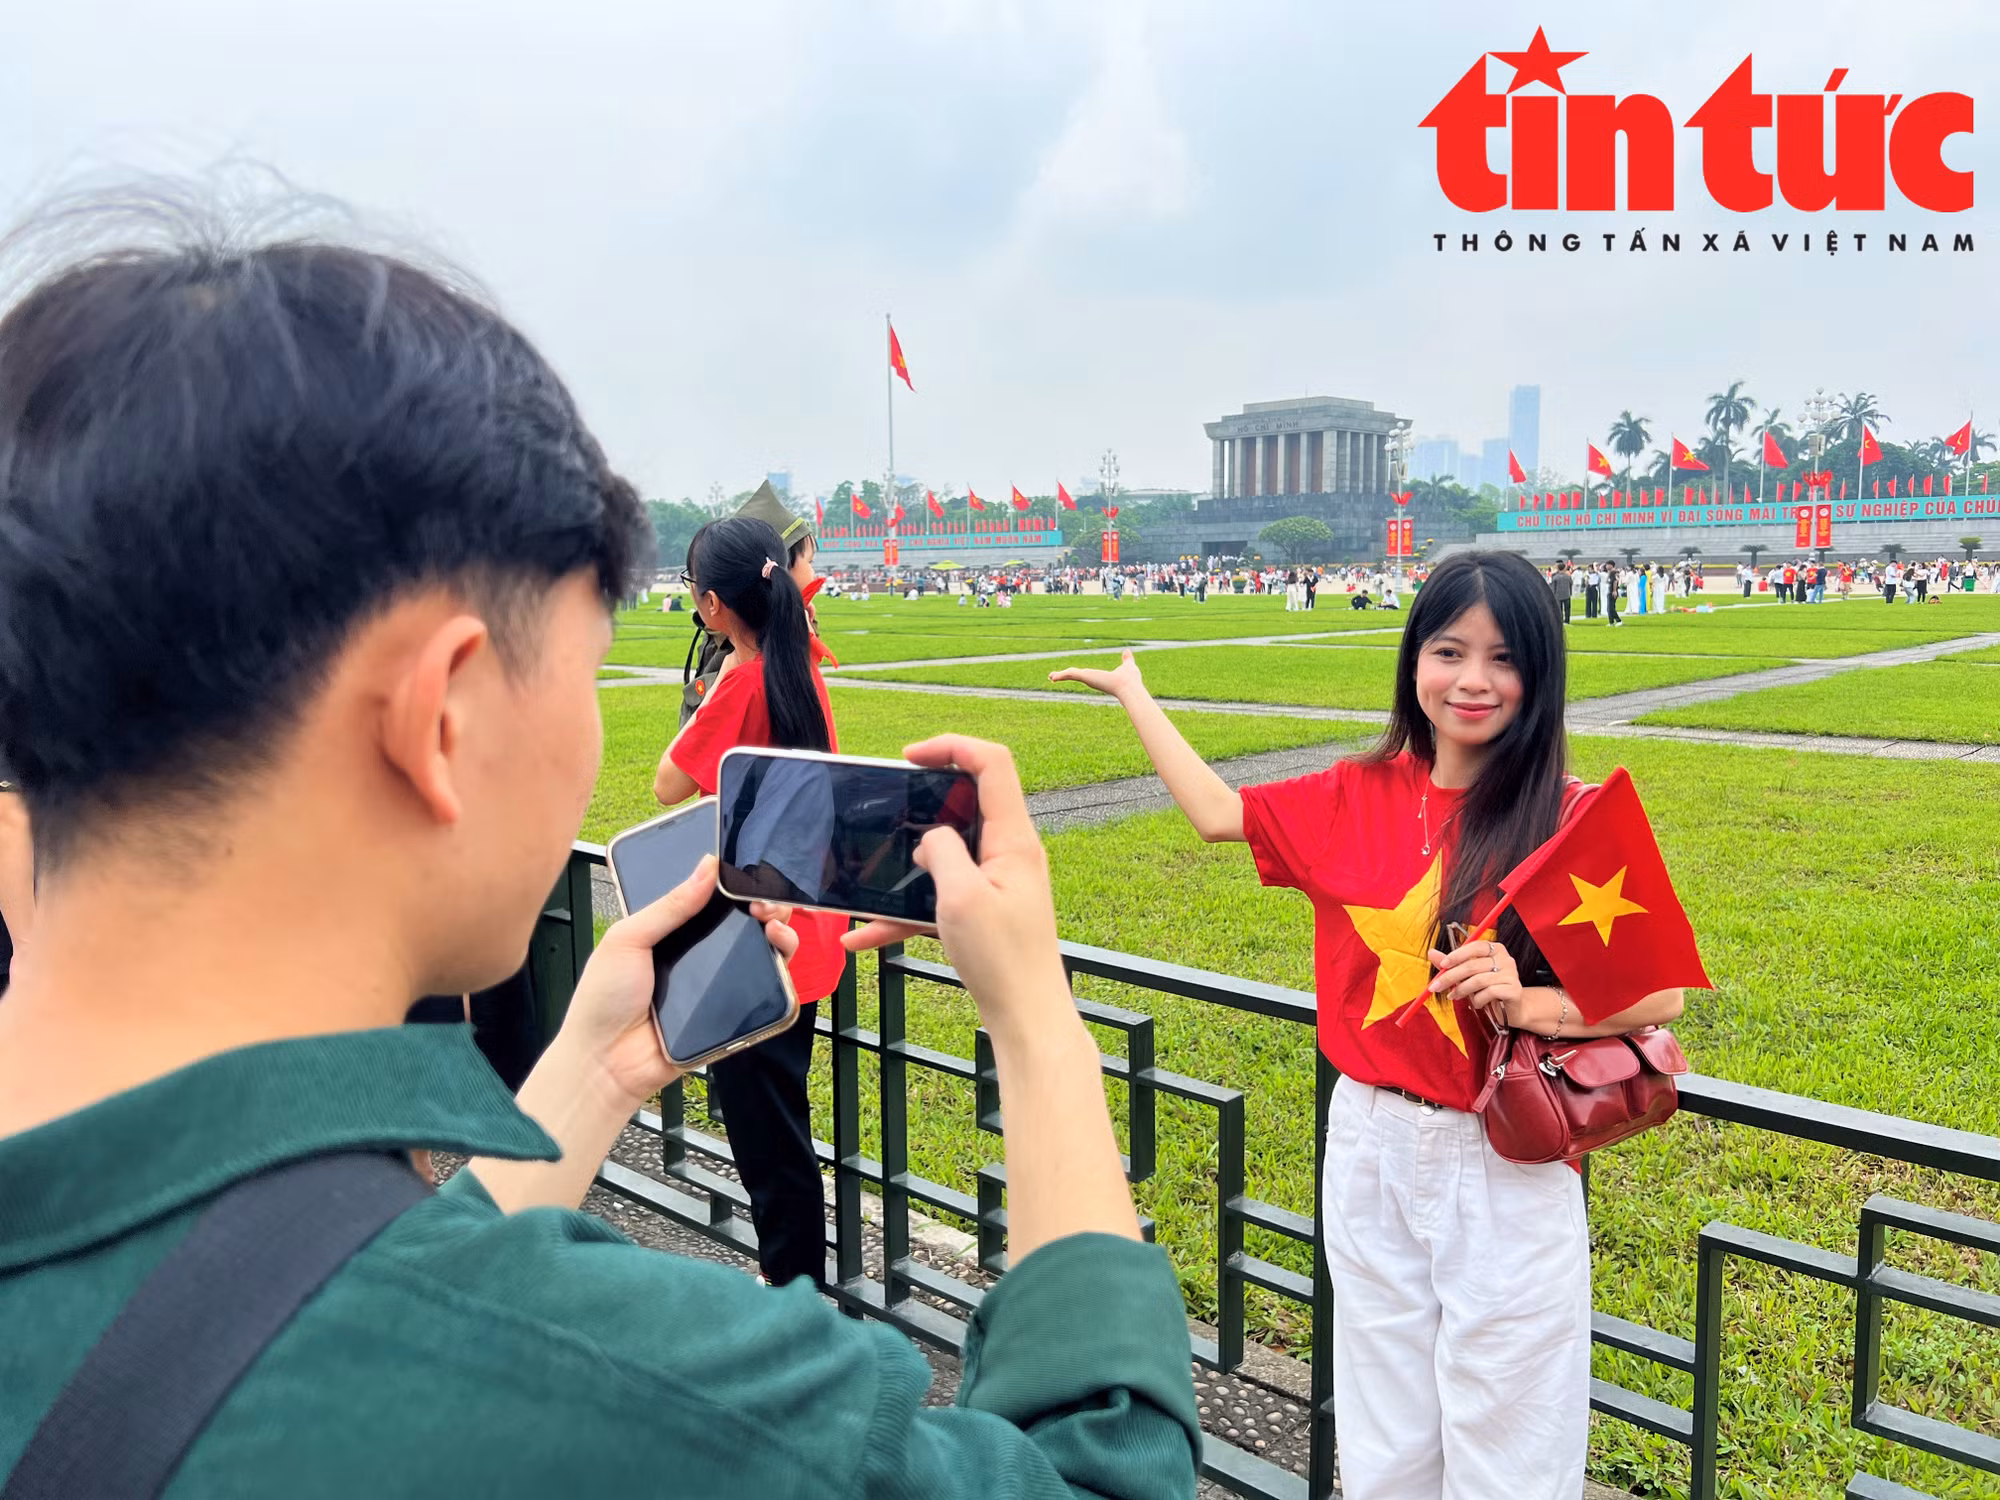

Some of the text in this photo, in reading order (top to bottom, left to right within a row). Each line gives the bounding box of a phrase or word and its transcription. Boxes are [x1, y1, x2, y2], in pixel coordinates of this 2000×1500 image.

[1621, 511, 1655, 525] MINH
[1835, 502, 1857, 520] SỰ
[1861, 499, 1919, 520] NGHIỆP
[1963, 496, 2000, 514] CHÚ
